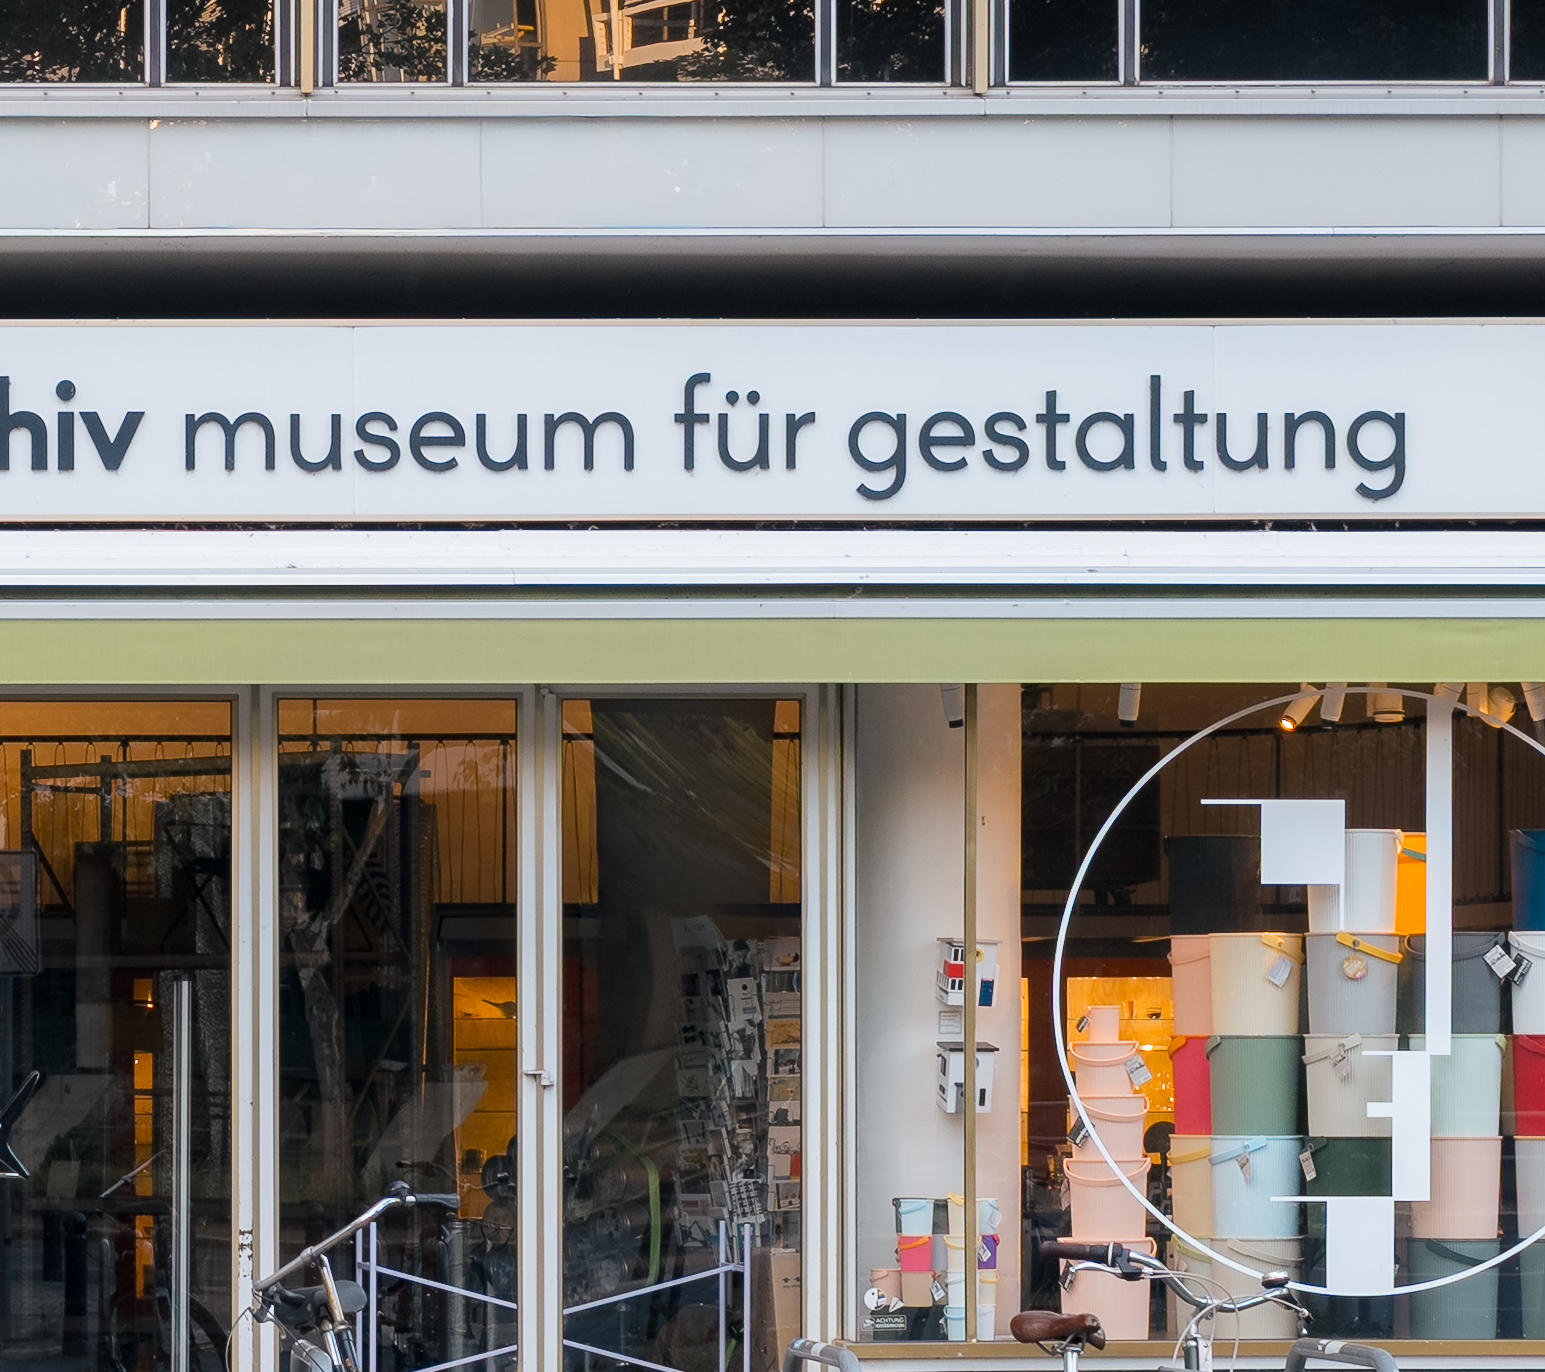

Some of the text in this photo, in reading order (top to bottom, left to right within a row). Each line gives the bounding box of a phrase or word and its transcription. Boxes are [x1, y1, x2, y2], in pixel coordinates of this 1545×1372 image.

[184, 411, 635, 475] museum
[674, 372, 816, 473] für
[847, 375, 1406, 504] gestaltung
